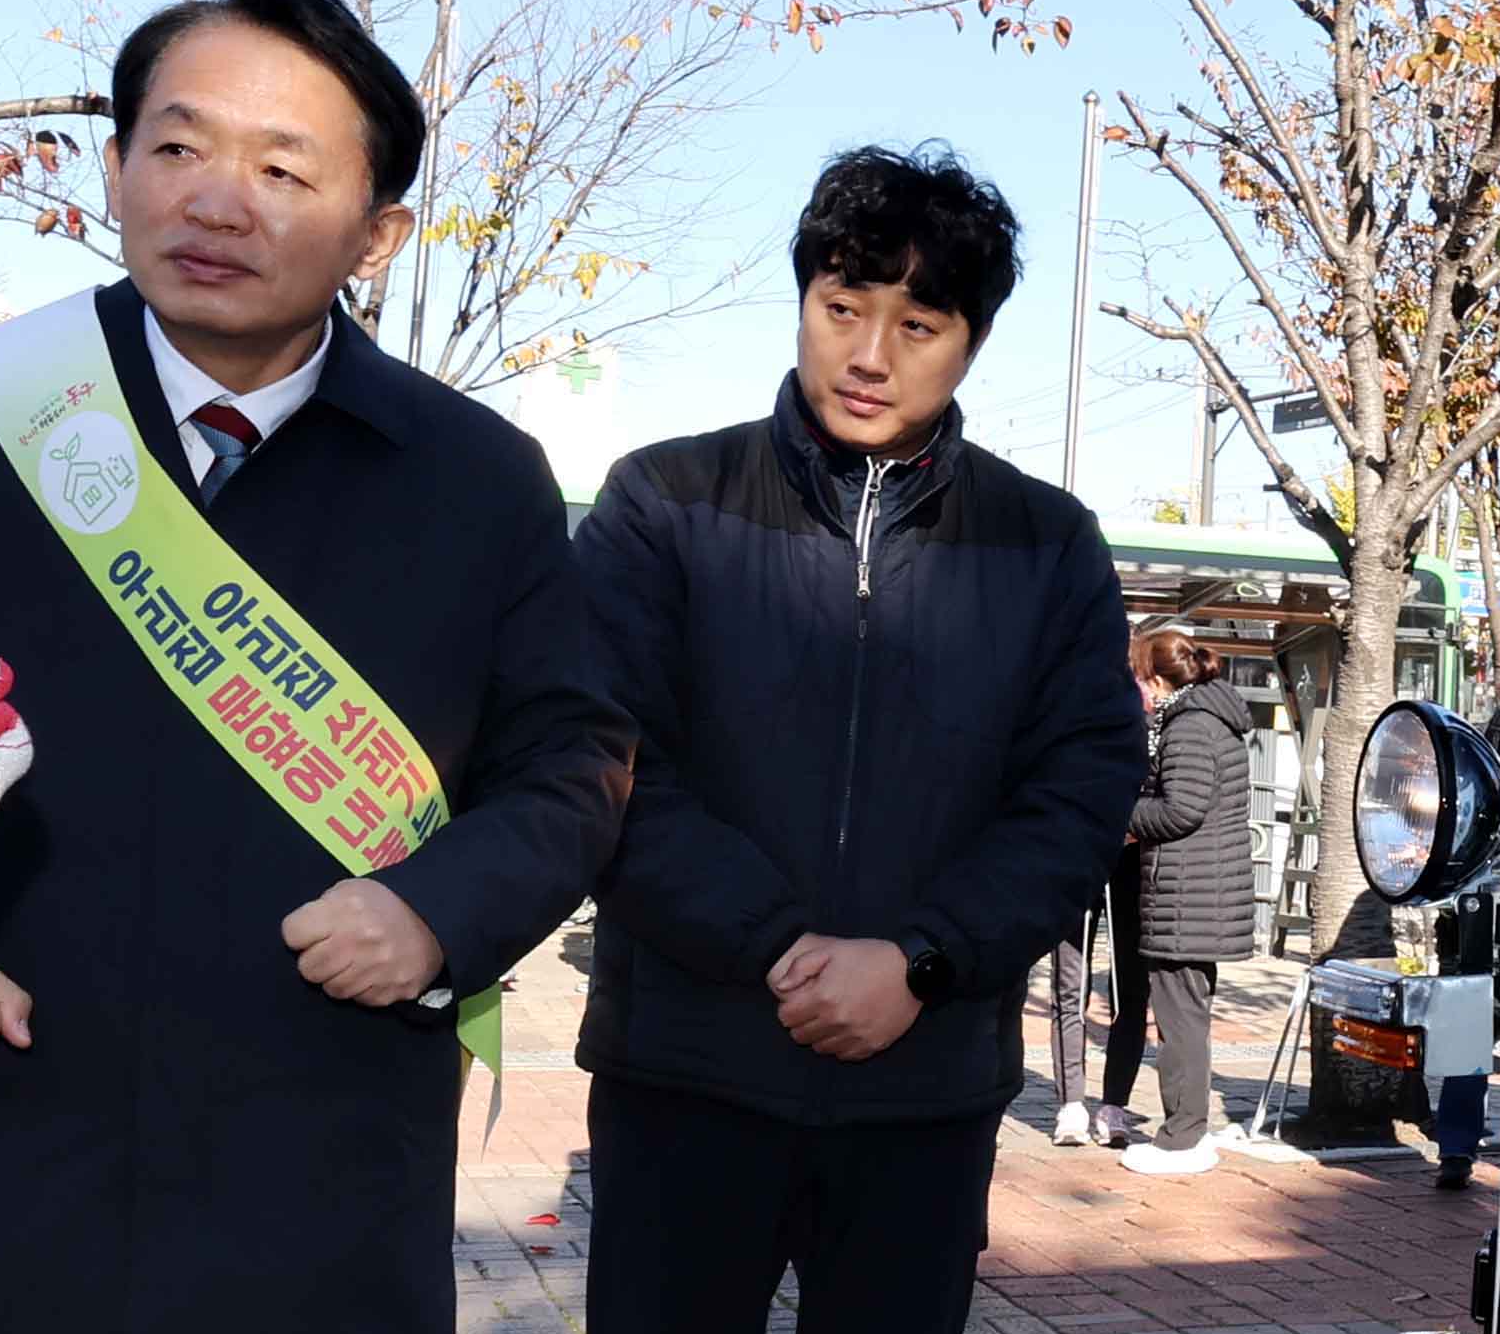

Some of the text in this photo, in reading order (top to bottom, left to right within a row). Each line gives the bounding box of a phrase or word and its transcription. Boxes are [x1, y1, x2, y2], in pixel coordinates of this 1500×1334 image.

[108, 549, 226, 687] 우리집
[206, 673, 346, 804] 문앞에
[203, 582, 338, 712] 우리집
